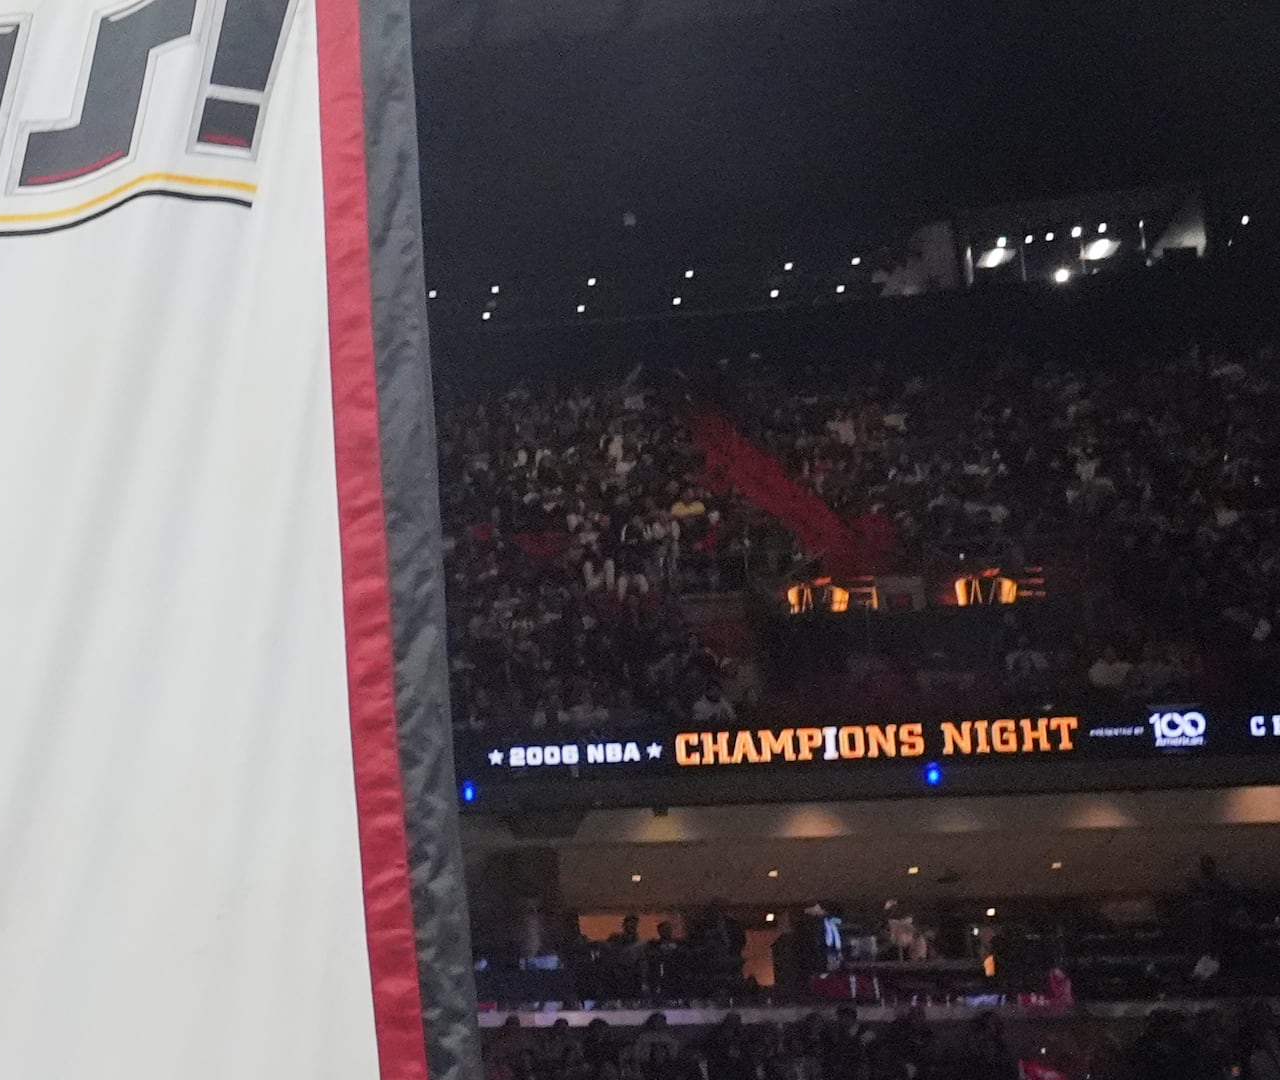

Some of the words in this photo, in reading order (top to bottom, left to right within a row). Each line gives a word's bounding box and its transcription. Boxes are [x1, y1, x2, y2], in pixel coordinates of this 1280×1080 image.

[509, 745, 579, 767] 2006
[586, 742, 641, 764] NBA
[675, 721, 925, 767] CHAMPIONS
[940, 716, 1078, 755] NIGHT
[1149, 711, 1206, 738] 100
